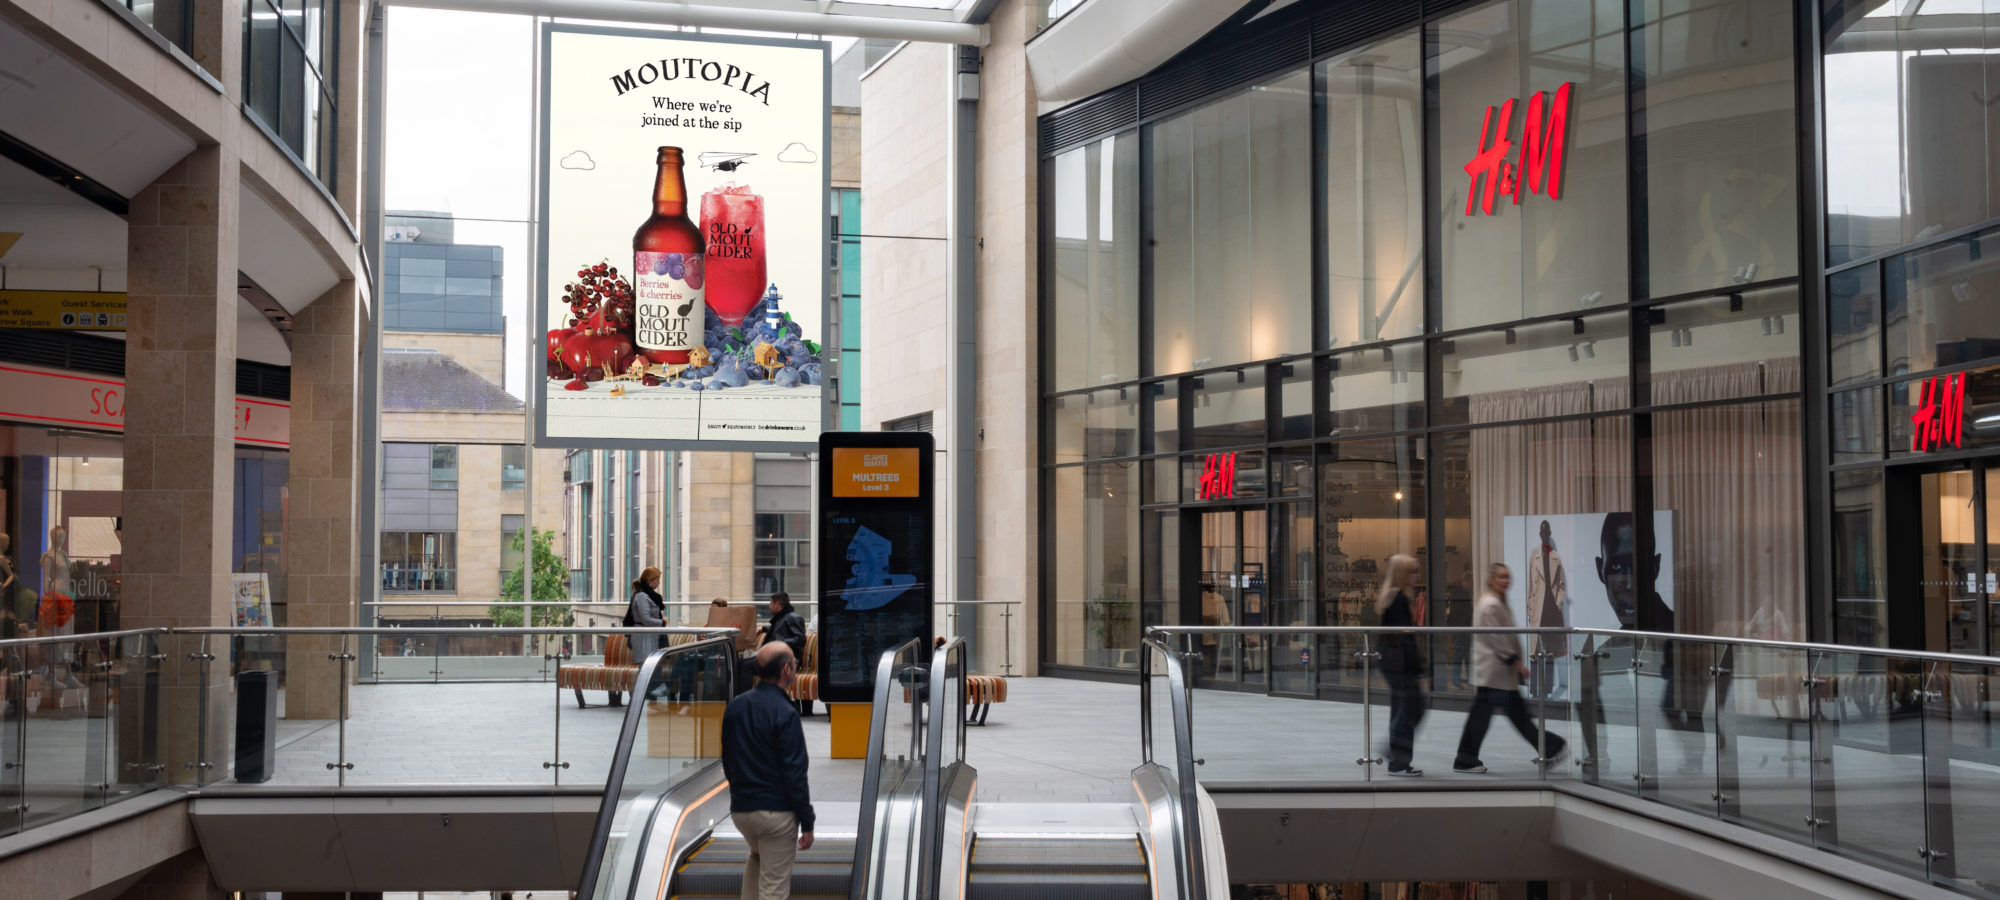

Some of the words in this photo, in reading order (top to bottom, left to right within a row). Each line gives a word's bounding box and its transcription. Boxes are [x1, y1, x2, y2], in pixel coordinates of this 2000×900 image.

[609, 57, 770, 107] MOUTOPIA
[652, 96, 695, 111] Where
[699, 100, 732, 113] we're
[641, 113, 680, 128] joined
[683, 117, 697, 128] at
[699, 116, 720, 130] the
[723, 118, 743, 133] sip
[1463, 81, 1574, 216] H&M
[709, 222, 738, 234] OLD
[710, 234, 754, 246] MOUT
[708, 245, 753, 259] CIDER
[639, 278, 670, 289] Berries
[640, 290, 646, 299] &
[646, 290, 683, 300] cherries
[62, 300, 88, 308] Guest
[11, 308, 34, 316] Walk
[639, 304, 670, 318] OLD
[20, 318, 51, 328] Square
[639, 317, 691, 331] MOUT
[638, 330, 689, 346] CIDER
[1912, 370, 1966, 453] H&M
[852, 472, 900, 482] MULTREES
[1199, 451, 1236, 501] H&M
[862, 483, 883, 491] Level
[1326, 482, 1353, 493] Women
[1326, 497, 1341, 508] Men
[1326, 512, 1353, 524] Divided
[1326, 528, 1344, 541] Baby
[1326, 562, 1342, 573] Click
[1326, 578, 1349, 590] Online
